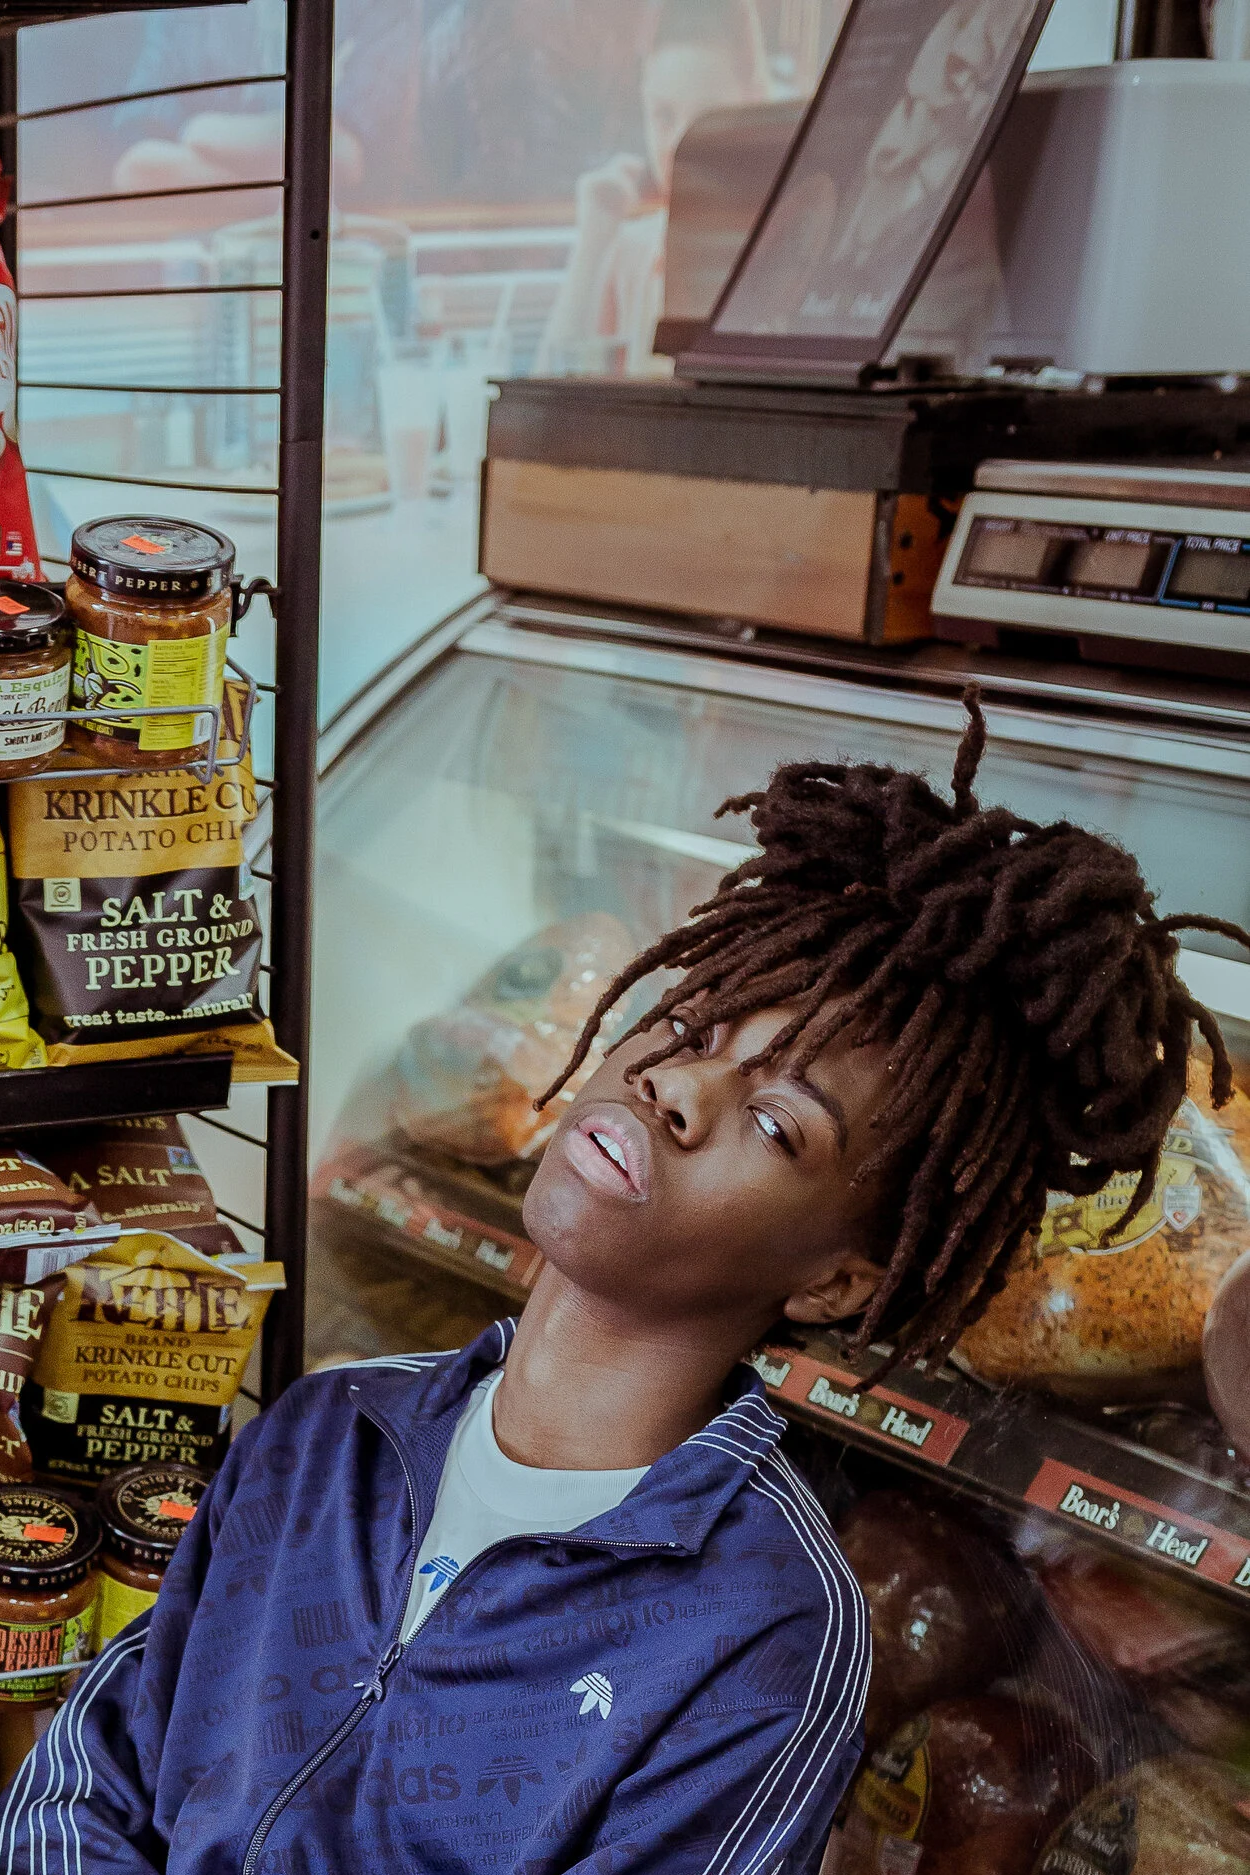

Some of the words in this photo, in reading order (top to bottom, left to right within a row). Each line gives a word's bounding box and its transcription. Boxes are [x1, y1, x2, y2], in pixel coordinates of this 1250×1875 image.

[100, 888, 203, 928] SALT
[209, 892, 233, 922] &
[65, 928, 149, 953] FRESH
[157, 918, 254, 949] GROUND
[85, 945, 241, 991] PEPPER
[808, 1377, 861, 1418] Boar's
[880, 1404, 934, 1448] Head
[85, 1439, 199, 1466] PEPPER
[1060, 1482, 1121, 1531] Boar's
[1145, 1520, 1210, 1567] Head
